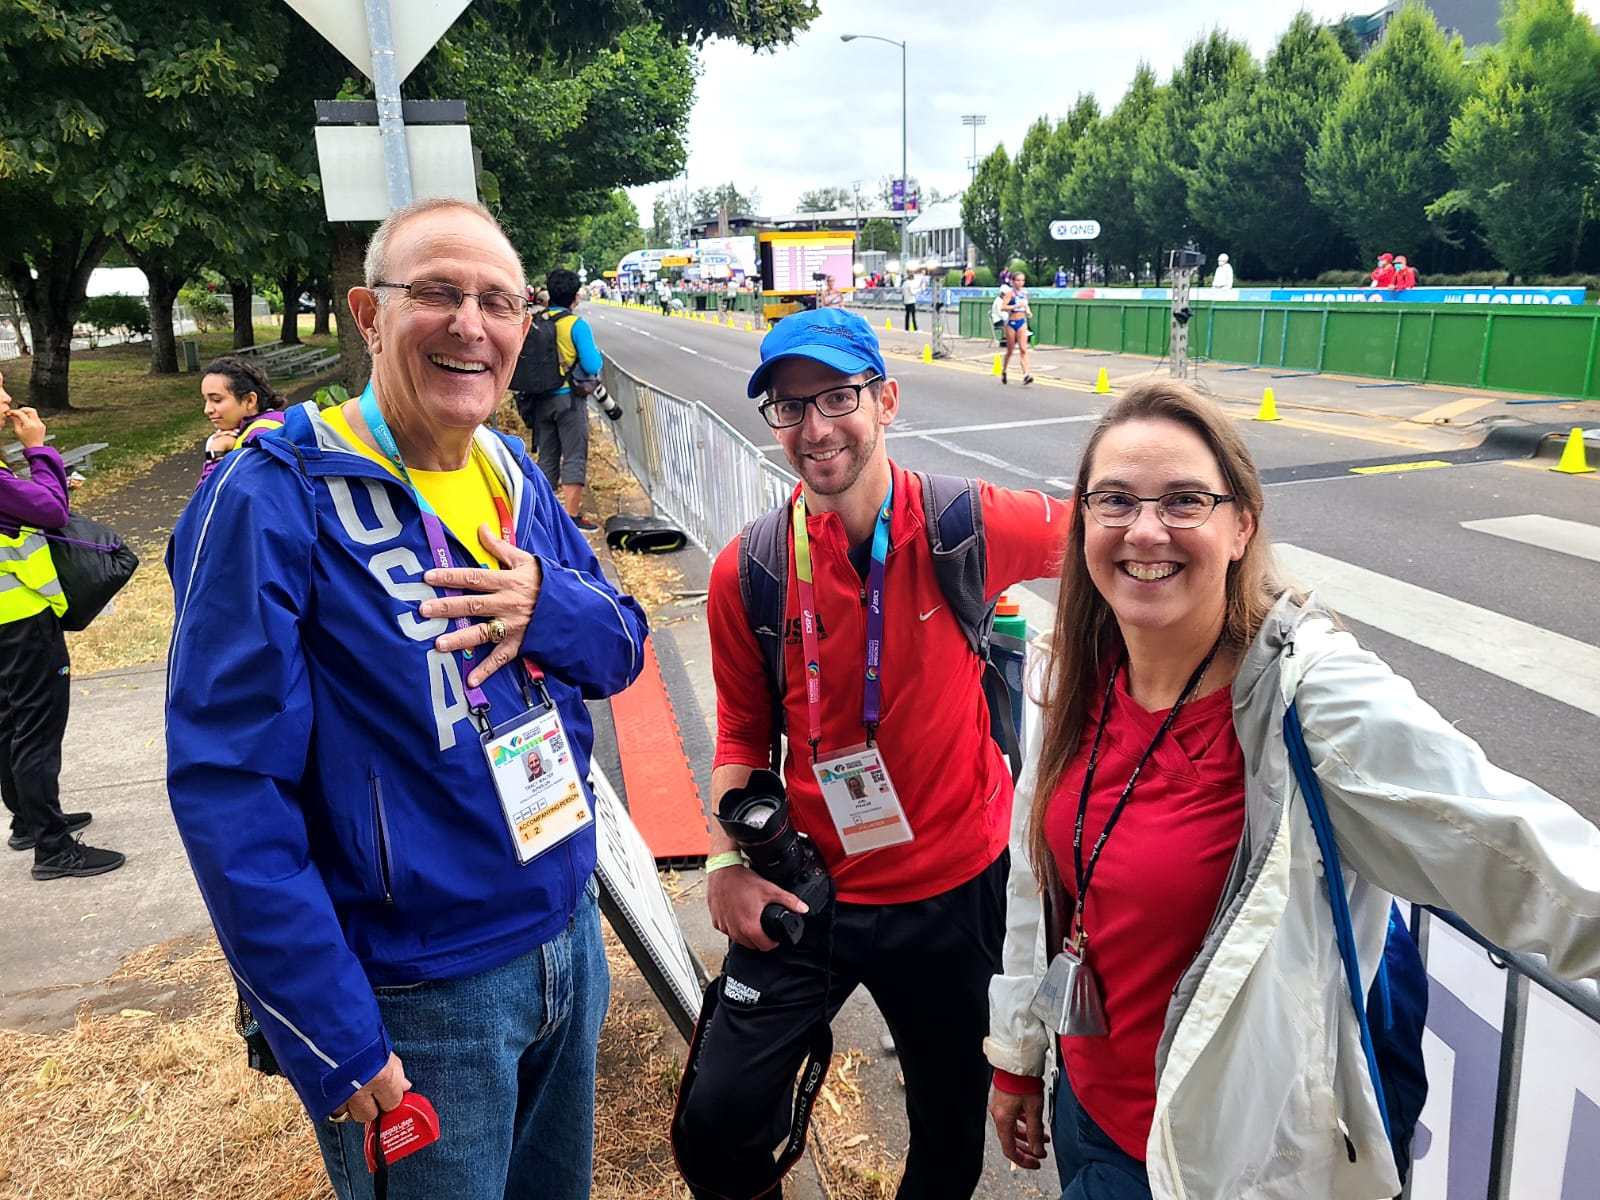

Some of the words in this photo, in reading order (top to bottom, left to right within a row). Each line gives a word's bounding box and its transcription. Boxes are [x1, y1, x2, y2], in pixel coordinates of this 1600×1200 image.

[1070, 224, 1095, 235] QNB
[324, 476, 486, 752] USA
[576, 811, 586, 822] 12
[805, 1062, 821, 1092] EOS
